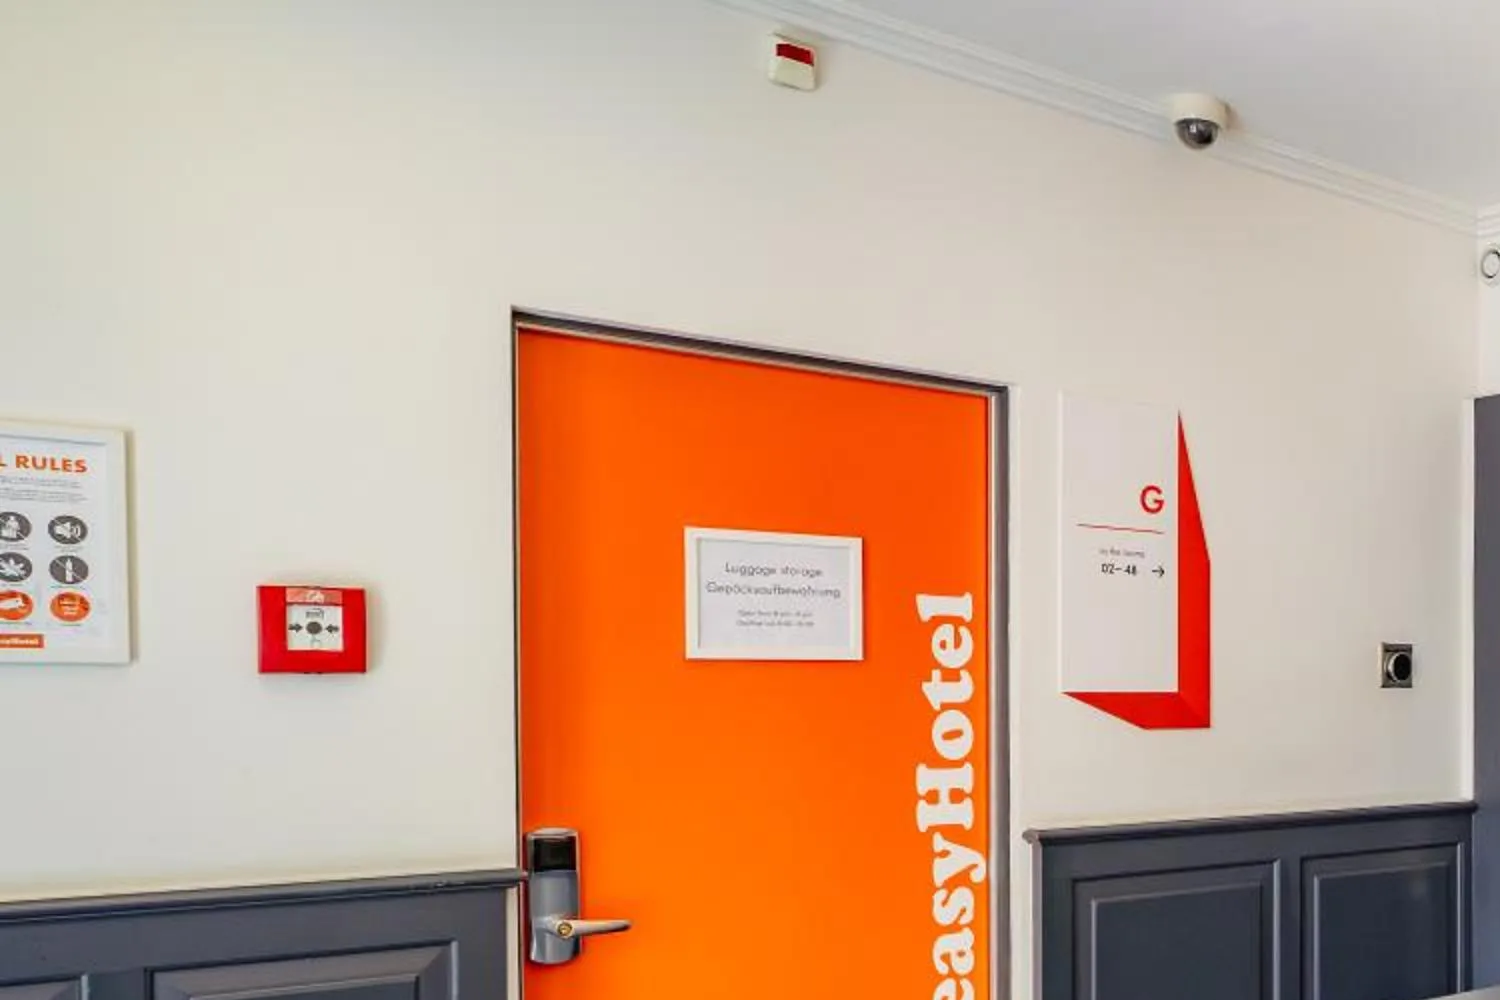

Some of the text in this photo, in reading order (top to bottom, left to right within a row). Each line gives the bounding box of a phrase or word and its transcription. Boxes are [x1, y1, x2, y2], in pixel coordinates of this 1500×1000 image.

[15, 454, 88, 473] RULES
[1140, 485, 1165, 514] G
[725, 562, 823, 578] Luggage storage
